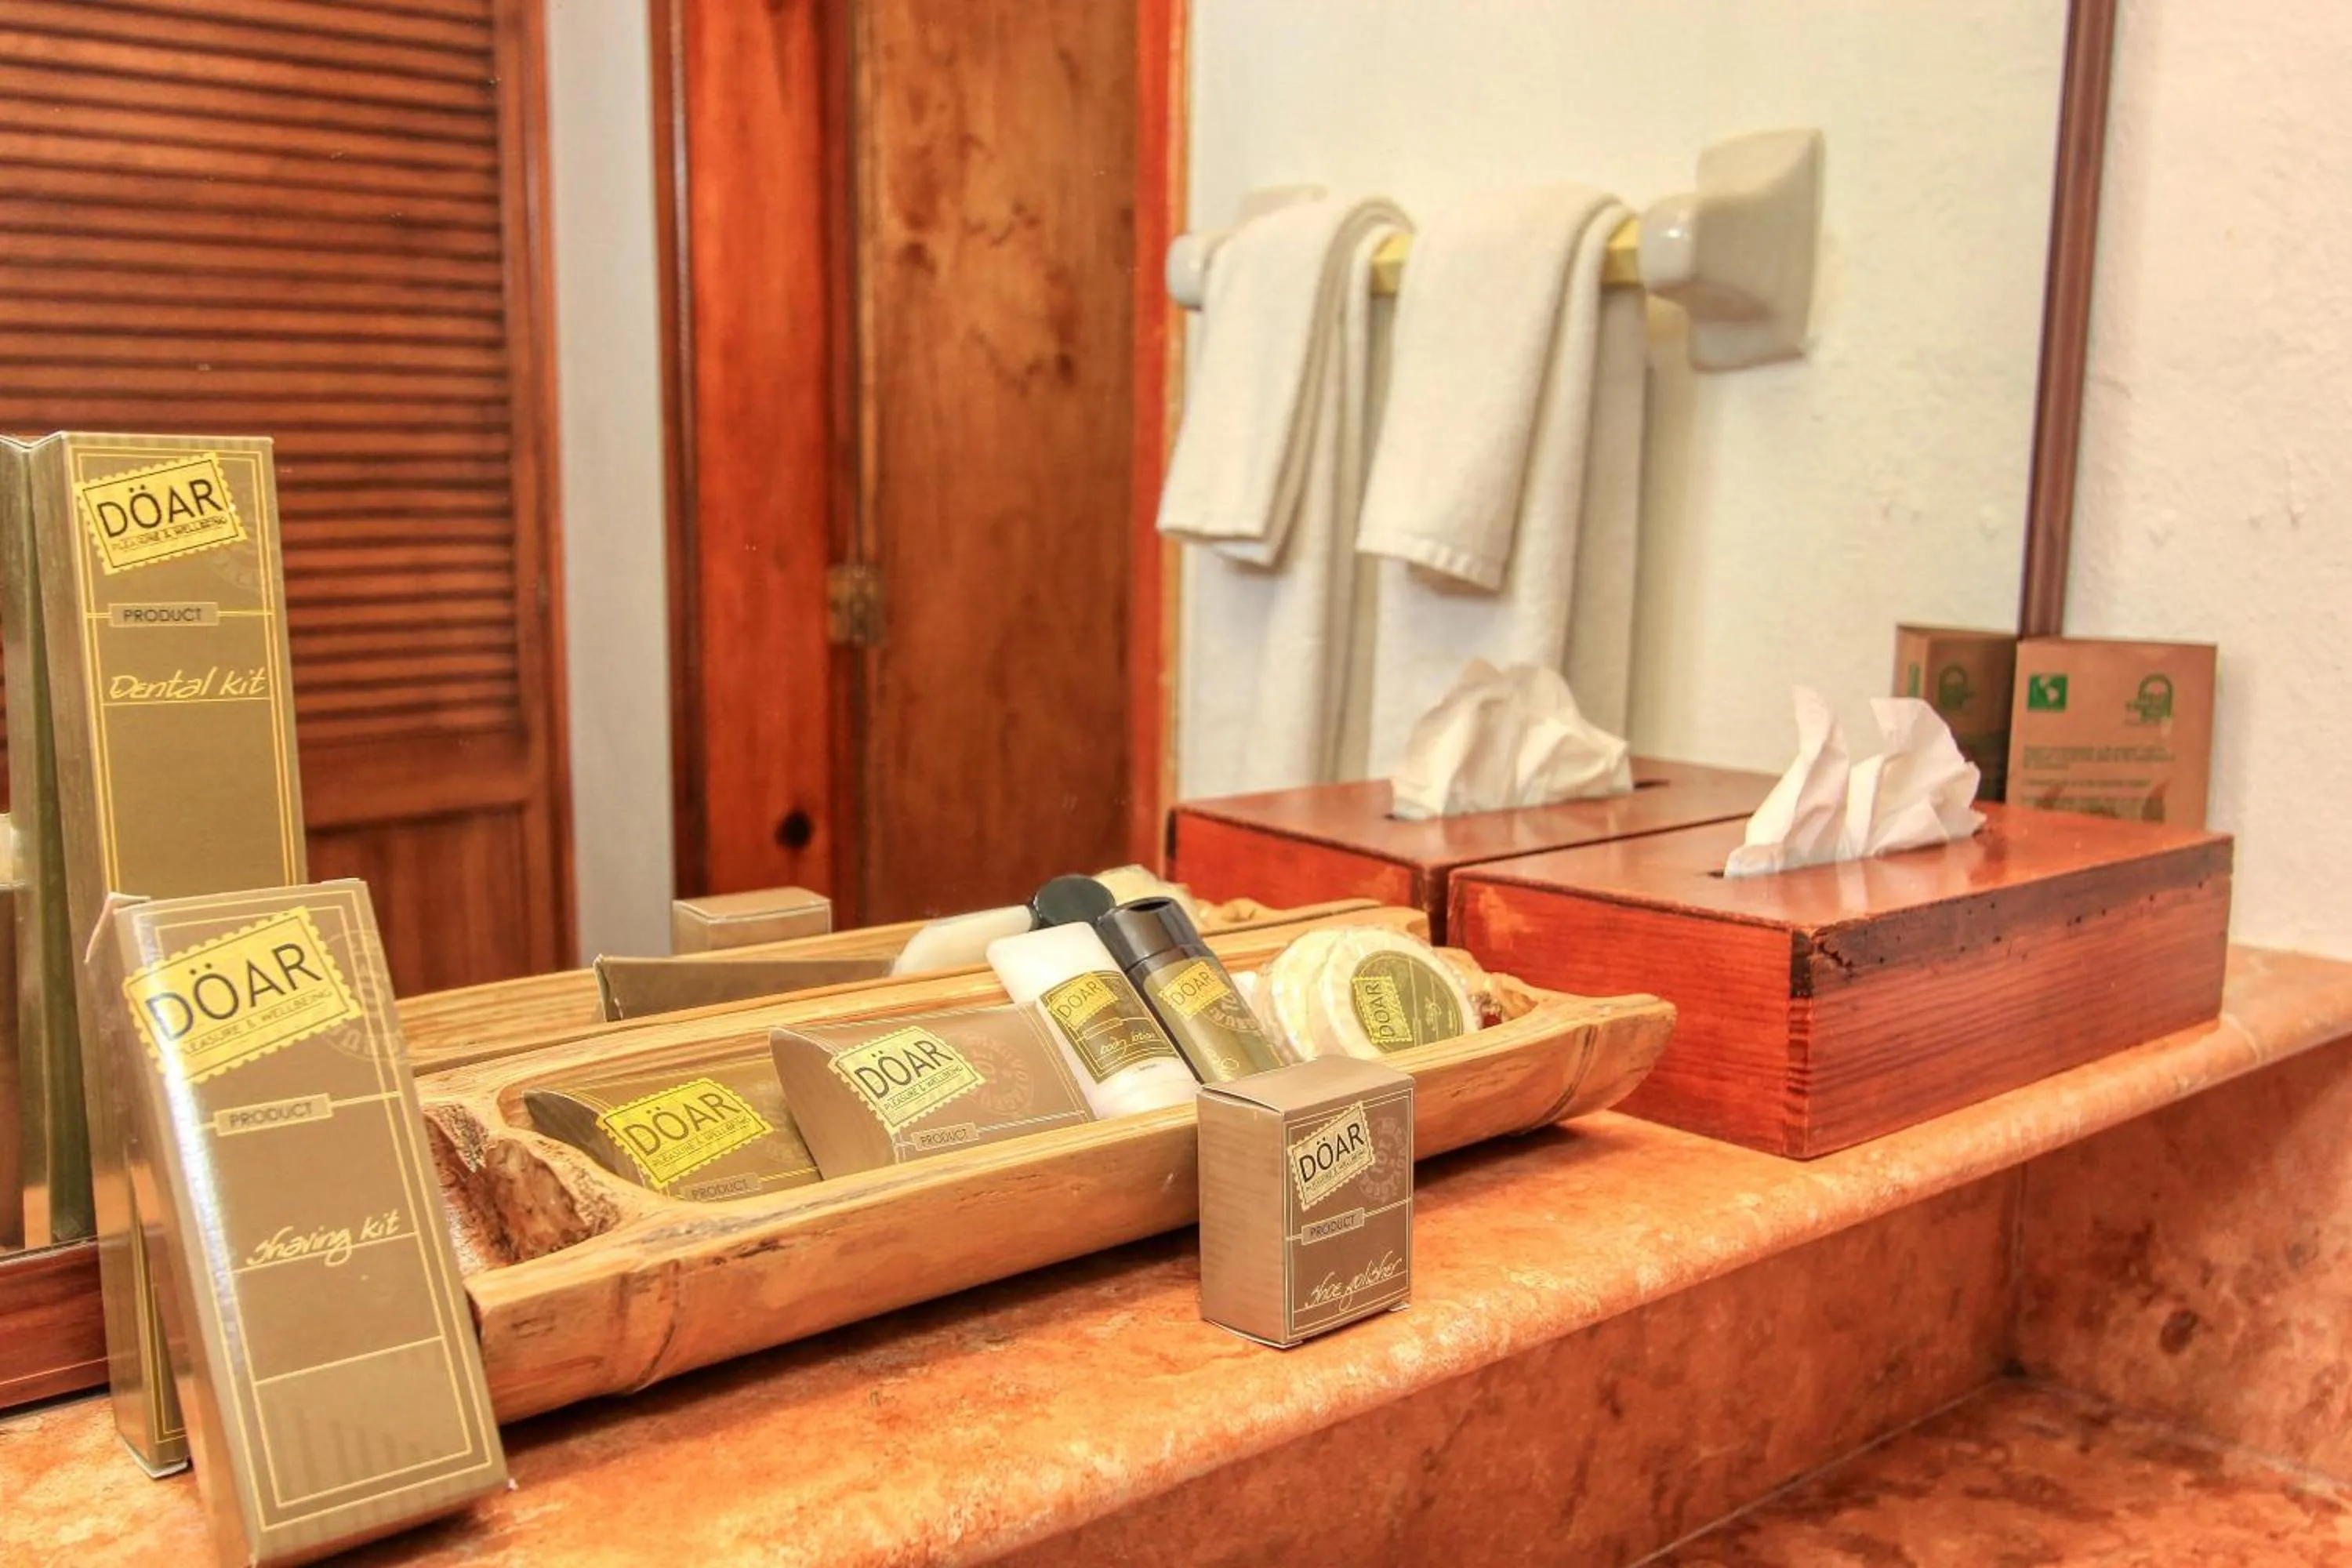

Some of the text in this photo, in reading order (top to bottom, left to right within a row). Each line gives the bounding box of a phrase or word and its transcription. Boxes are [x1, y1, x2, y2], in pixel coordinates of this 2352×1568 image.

[97, 478, 223, 538] DÖAR
[123, 607, 202, 622] PRODUCT
[110, 667, 266, 699] Dental kit
[145, 943, 322, 1042] DÖAR
[853, 1040, 953, 1099] DÖAR
[229, 1102, 314, 1129] PRODUCT
[623, 1092, 741, 1156] DÖAR
[1299, 1123, 1364, 1182] DÖAR
[361, 1208, 401, 1241] kit
[1310, 1216, 1356, 1238] PRODUCT
